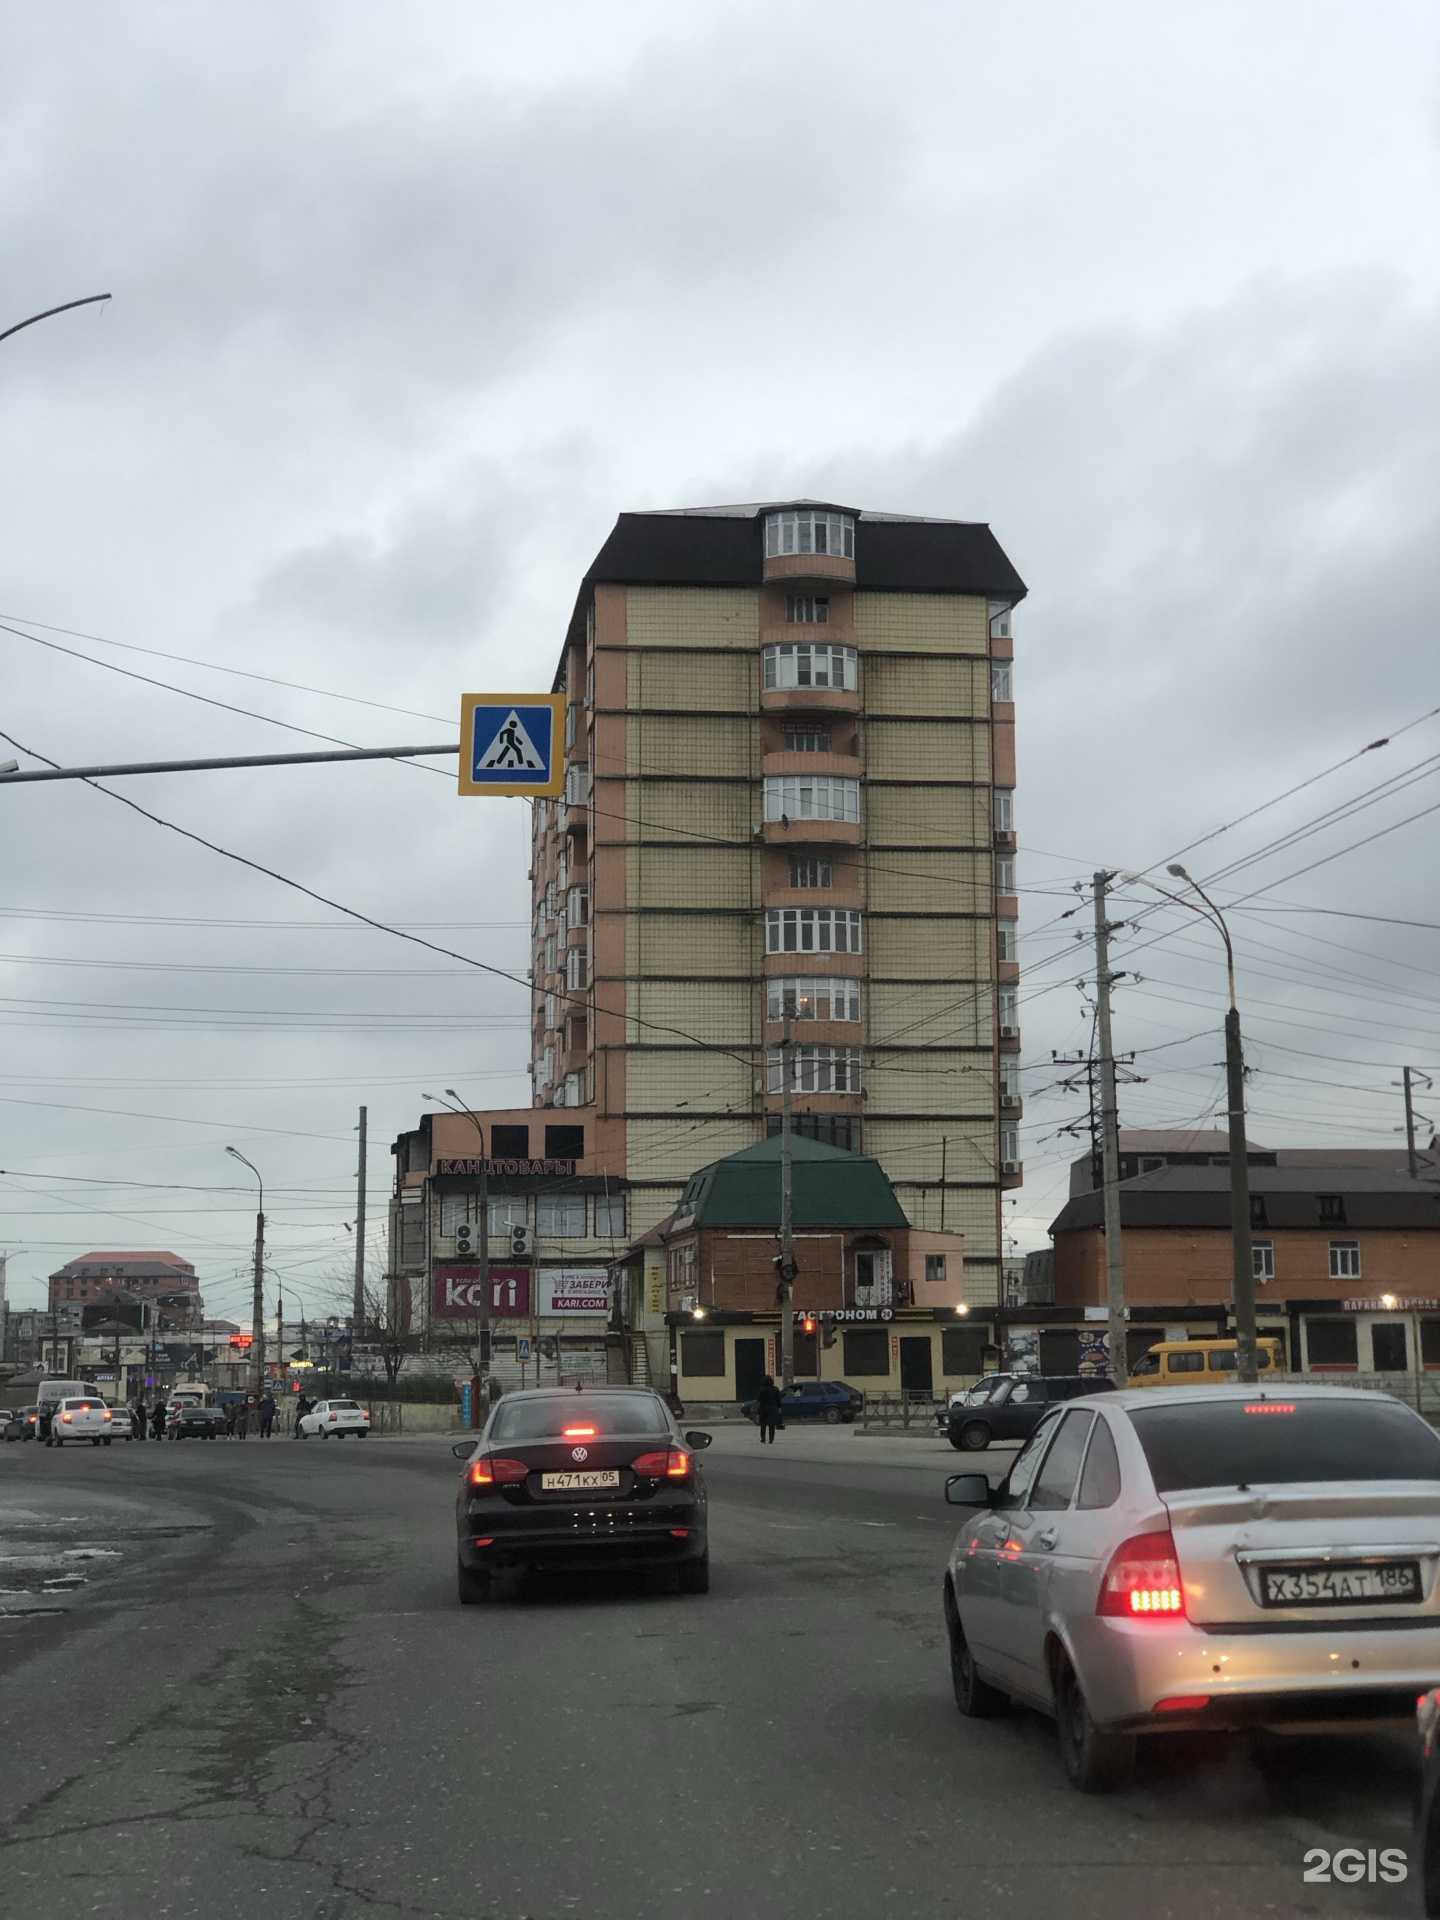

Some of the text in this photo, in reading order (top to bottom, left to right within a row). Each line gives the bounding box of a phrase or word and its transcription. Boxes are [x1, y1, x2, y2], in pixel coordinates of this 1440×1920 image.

[557, 1299, 605, 1308] KARI.COM
[602, 1471, 615, 1482] 05
[1272, 1571, 1367, 1598] Х354АТ
